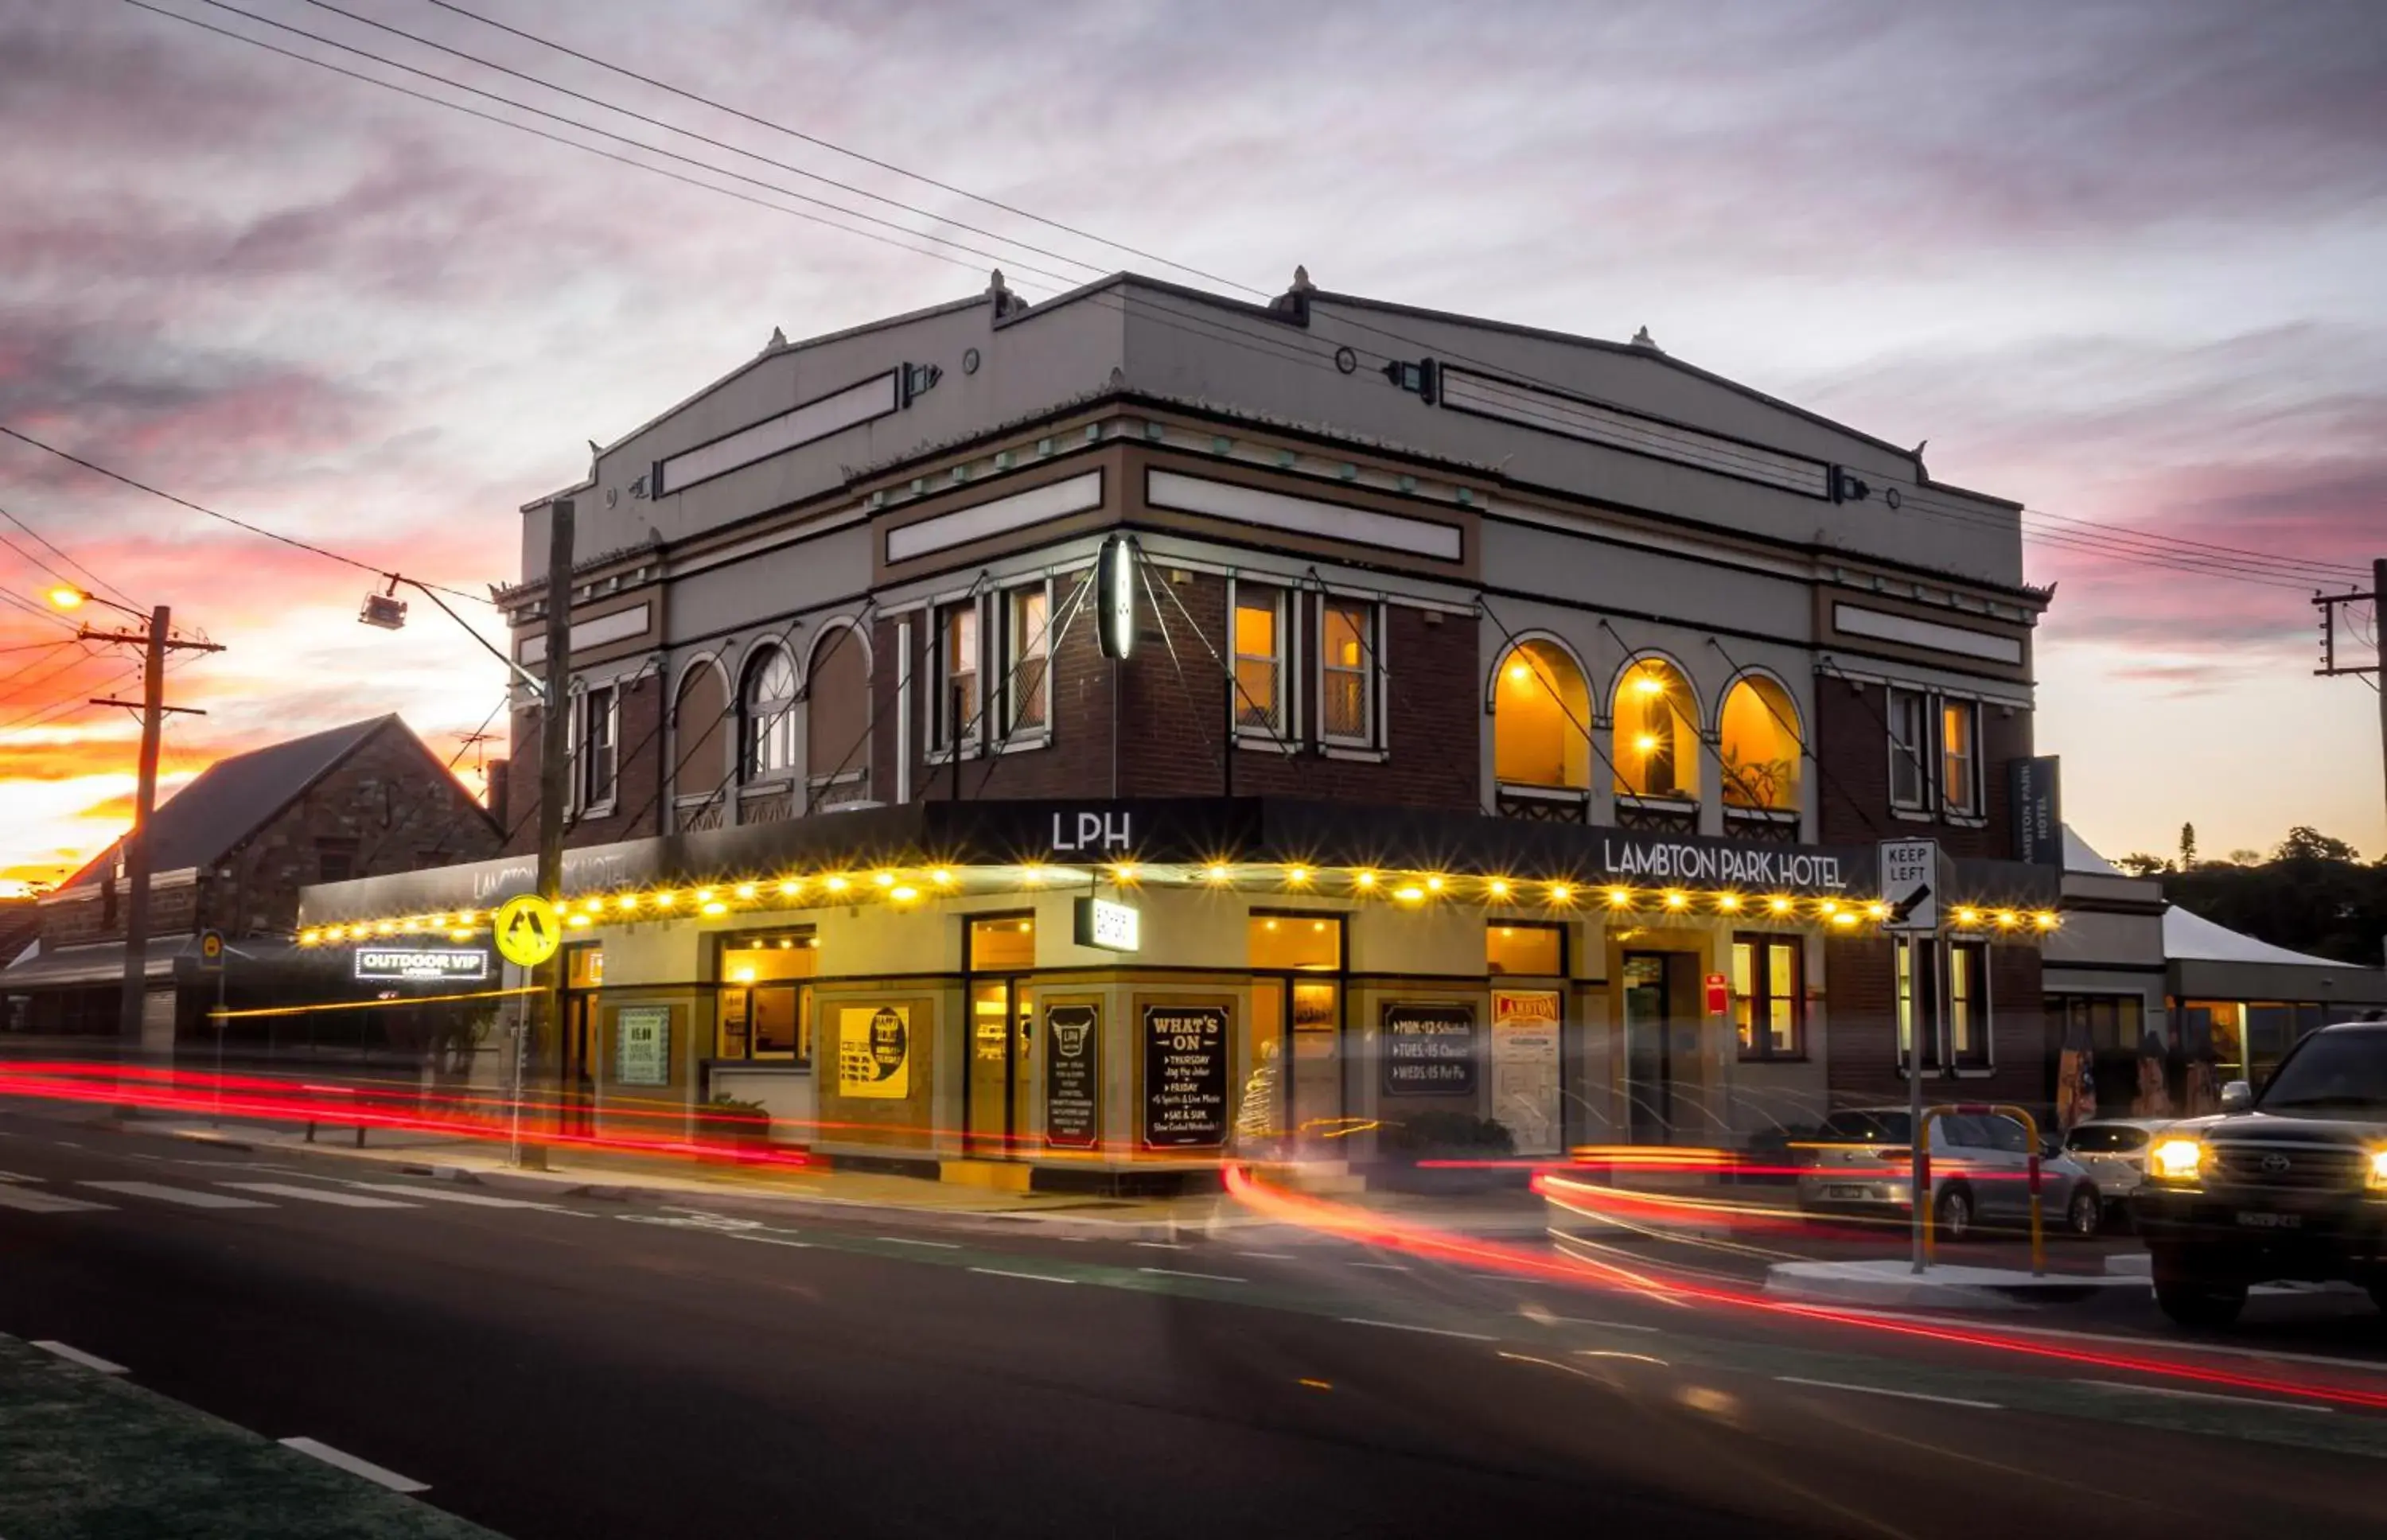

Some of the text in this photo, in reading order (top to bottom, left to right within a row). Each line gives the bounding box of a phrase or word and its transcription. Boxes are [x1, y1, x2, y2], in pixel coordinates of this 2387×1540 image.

[2037, 796, 2047, 840] HOTEL
[1053, 812, 1130, 850] LPH
[1888, 848, 1926, 863] KEEP
[1605, 838, 1847, 889] LAMBTON PARK HOTEL
[1891, 866, 1925, 881] LEFT
[364, 953, 480, 968] OUTDOOR VIP
[1153, 1015, 1218, 1033] WHAT'S
[1173, 1035, 1201, 1050] ON
[1170, 1056, 1210, 1065] THURSDAY
[1170, 1083, 1198, 1092] FRIDAY
